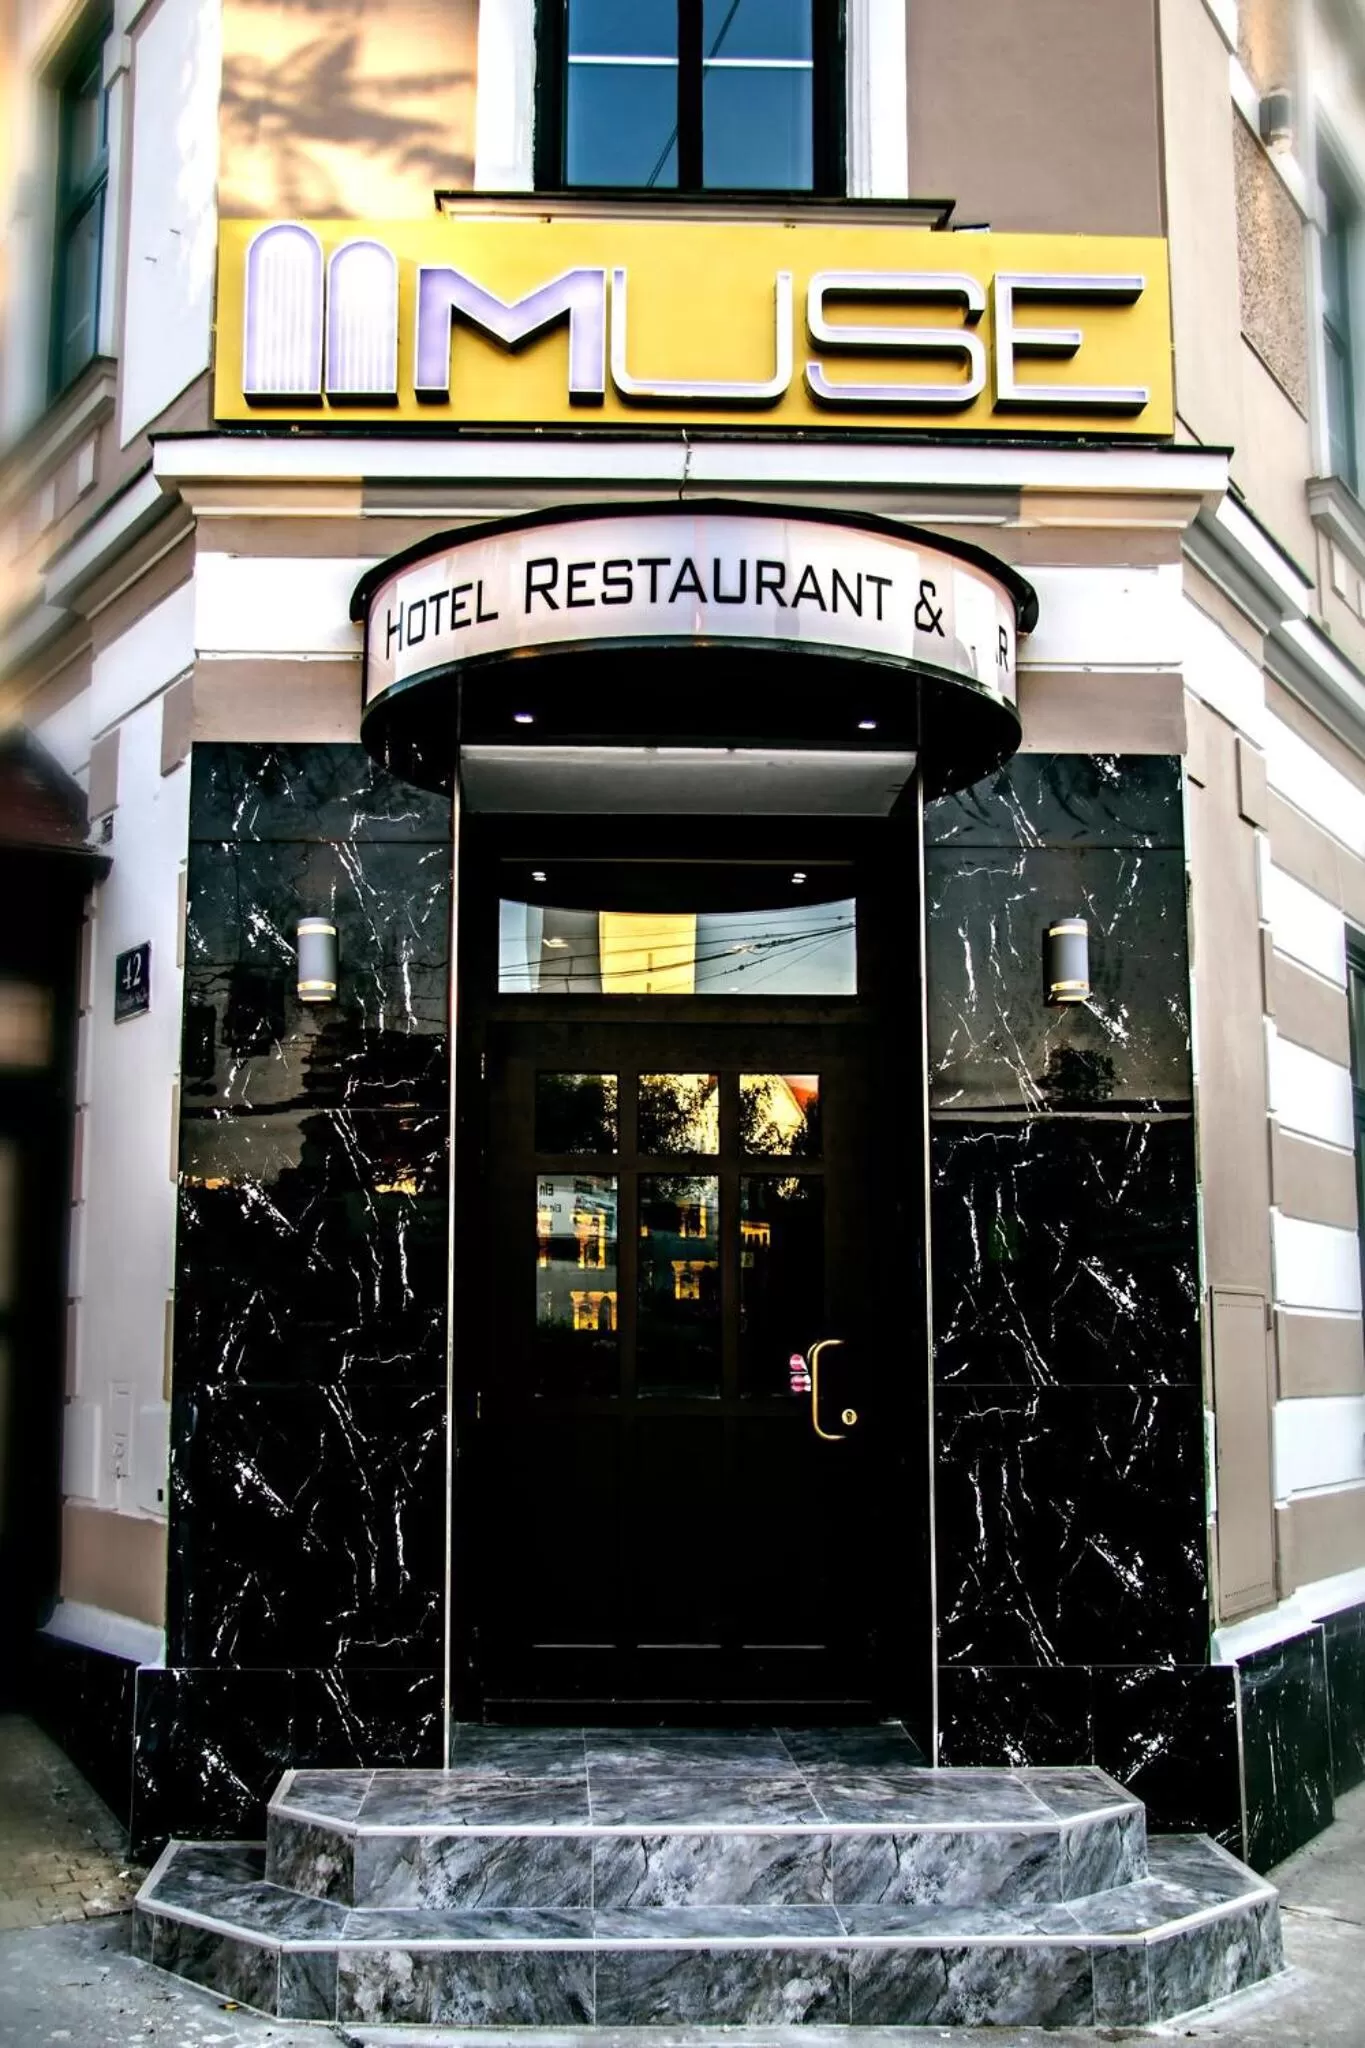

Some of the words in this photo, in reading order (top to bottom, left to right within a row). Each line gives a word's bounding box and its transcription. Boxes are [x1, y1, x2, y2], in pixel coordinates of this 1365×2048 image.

[414, 266, 1151, 413] MUSE
[386, 580, 498, 659] HOTEL
[525, 557, 893, 621] RESTAURANT
[914, 579, 945, 637] &
